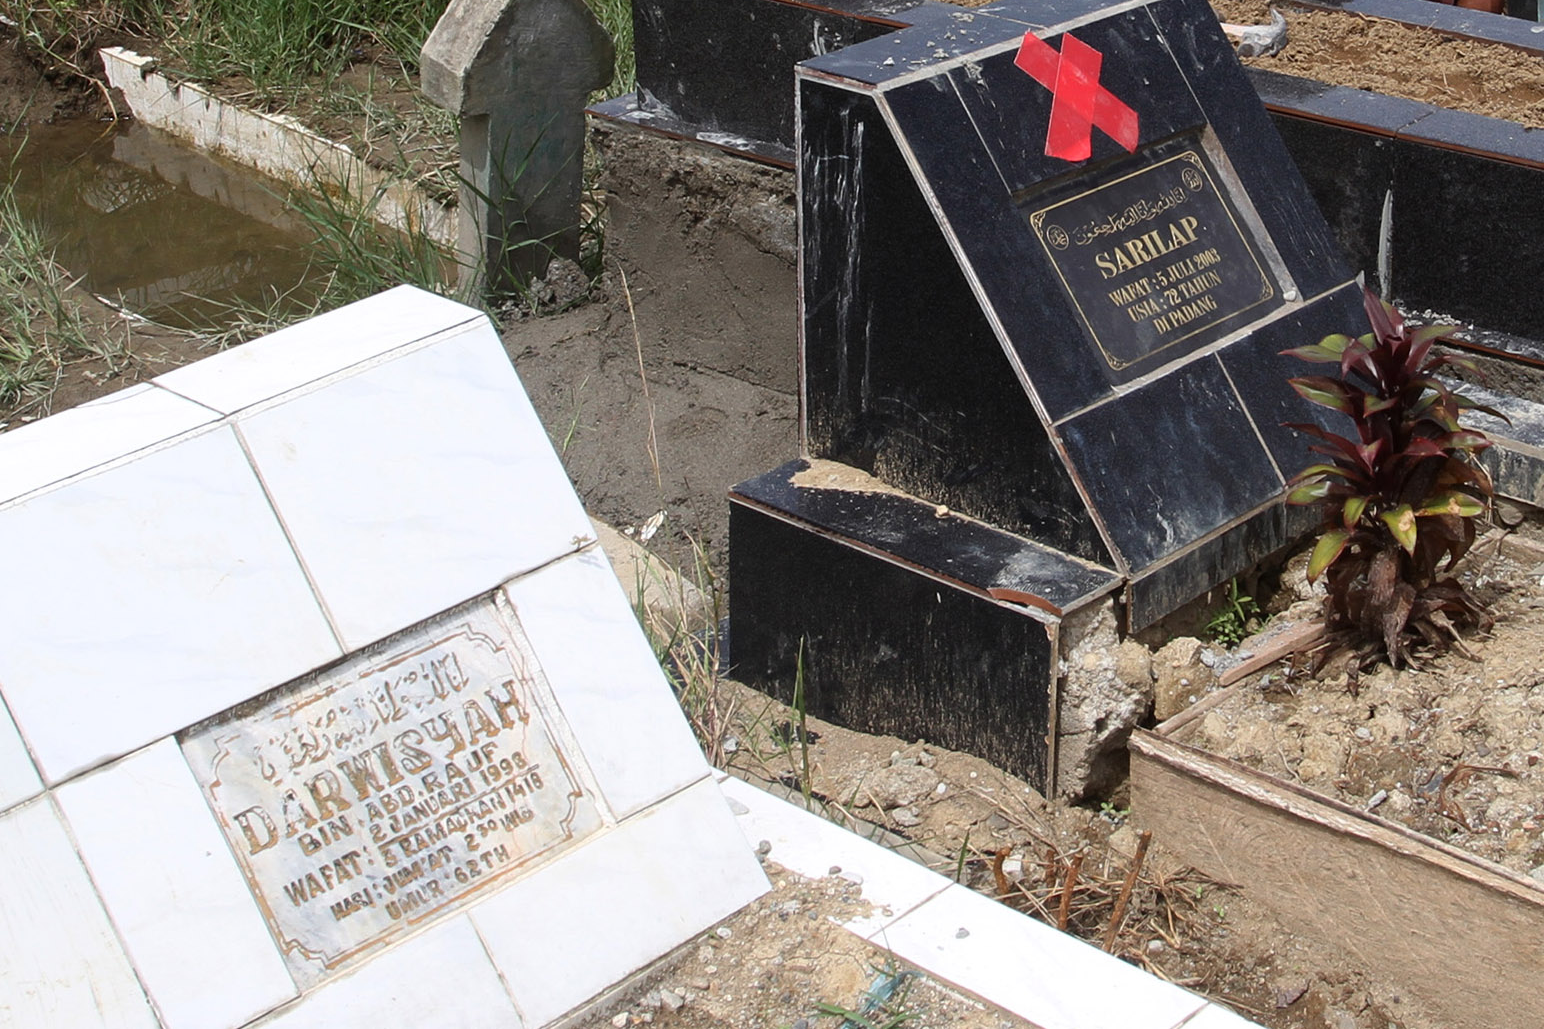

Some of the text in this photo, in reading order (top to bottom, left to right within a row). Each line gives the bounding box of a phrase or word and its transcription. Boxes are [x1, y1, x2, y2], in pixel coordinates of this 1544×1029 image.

[1095, 216, 1199, 280] SARILAP
[1108, 277, 1151, 307] WAFAT
[1166, 260, 1197, 283] JULI
[1127, 298, 1161, 322] USIA
[1164, 288, 1182, 306] 72
[1178, 269, 1223, 299] TAHUN
[1153, 294, 1218, 335] DI PADANG
[233, 679, 530, 856] DARWISYAH
[389, 777, 477, 834] JANUARI
